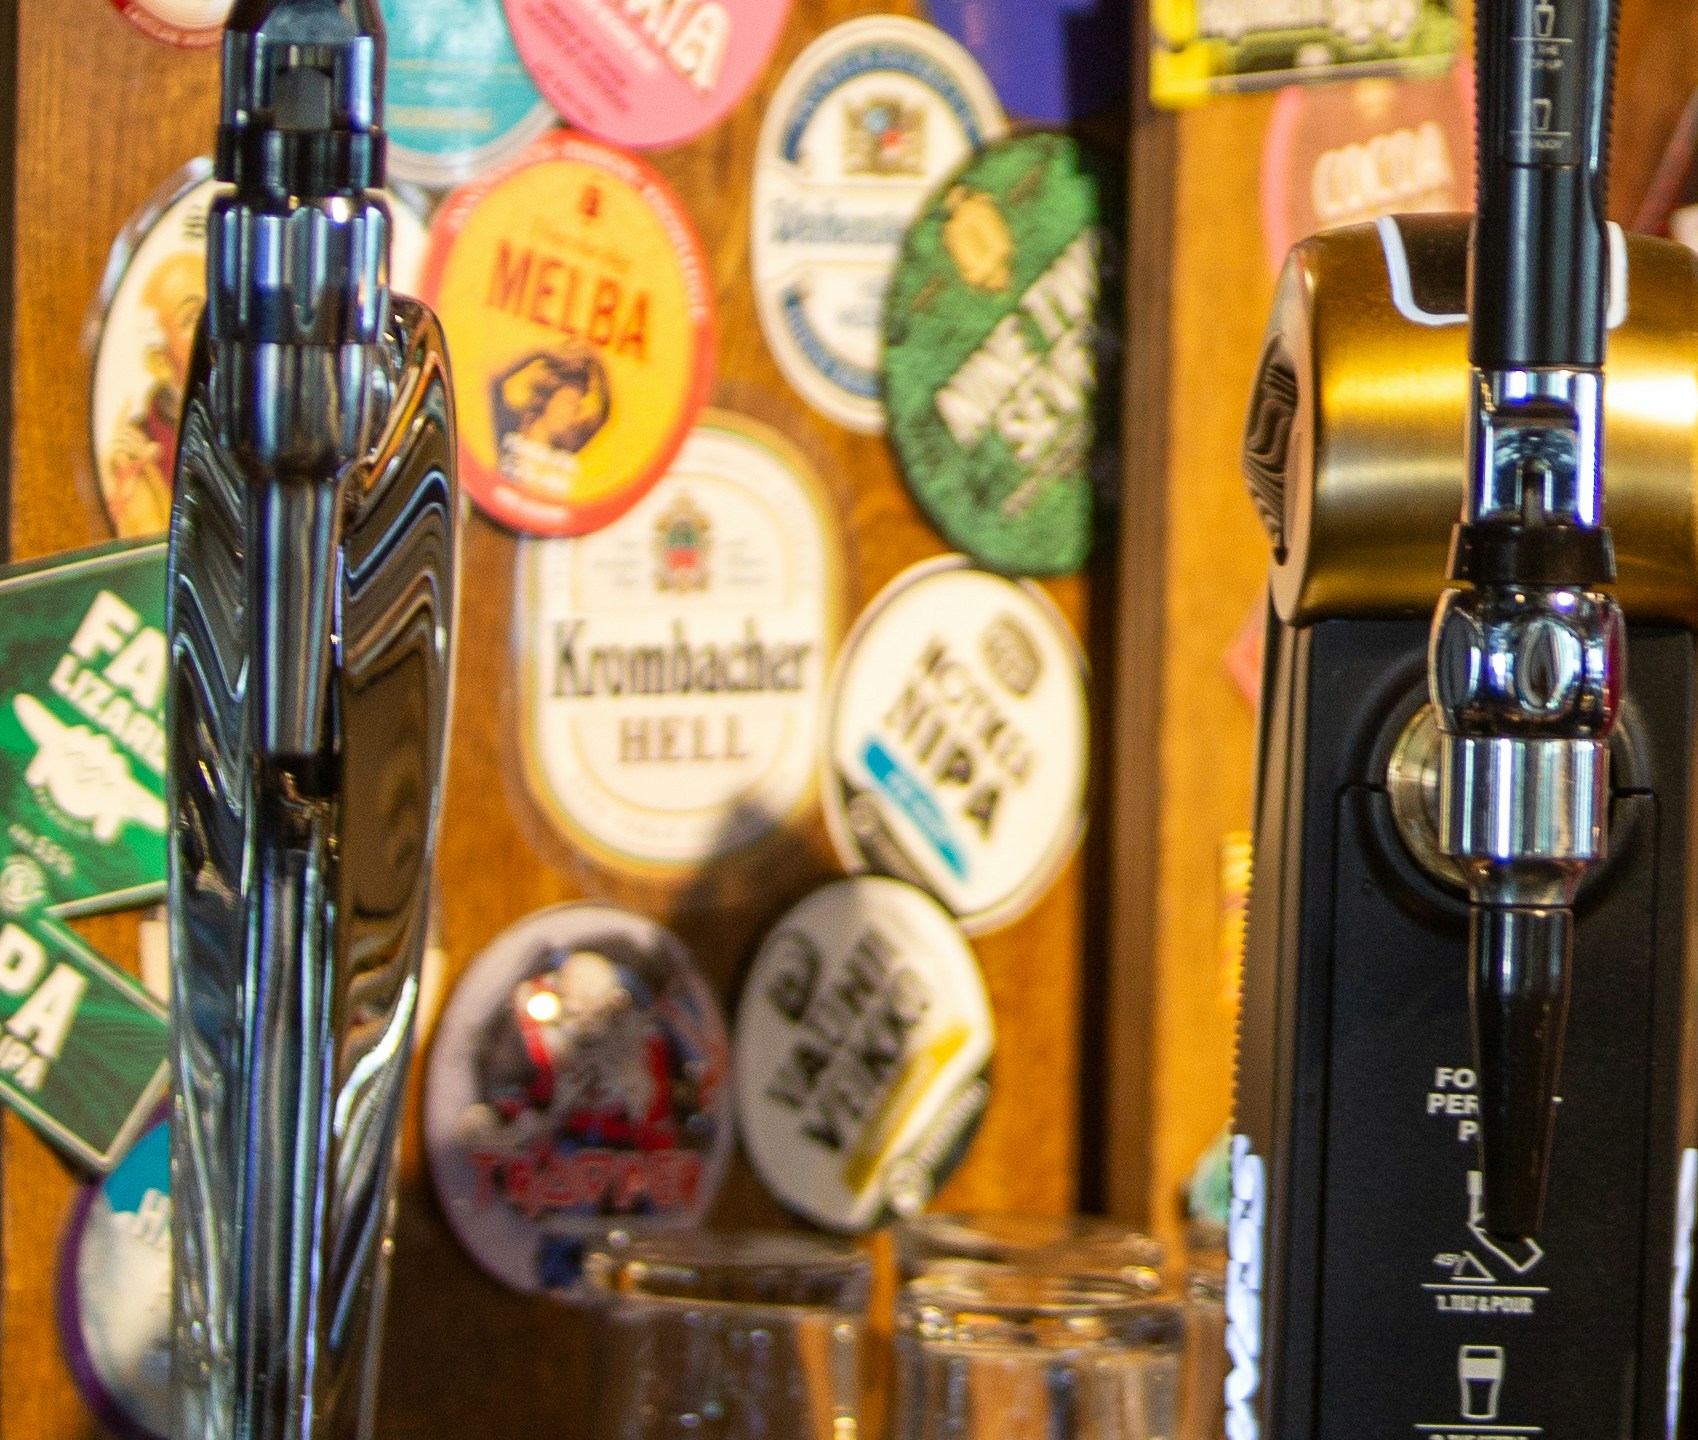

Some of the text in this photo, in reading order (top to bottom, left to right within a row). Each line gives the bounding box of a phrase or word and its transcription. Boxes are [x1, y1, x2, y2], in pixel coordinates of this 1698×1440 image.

[485, 240, 653, 364] MELBA
[70, 587, 168, 693] FA
[550, 616, 812, 697] Krombacher
[620, 717, 750, 763] HELL
[1434, 1066, 1478, 1089] FO
[468, 1145, 703, 1215] TRAPPER
